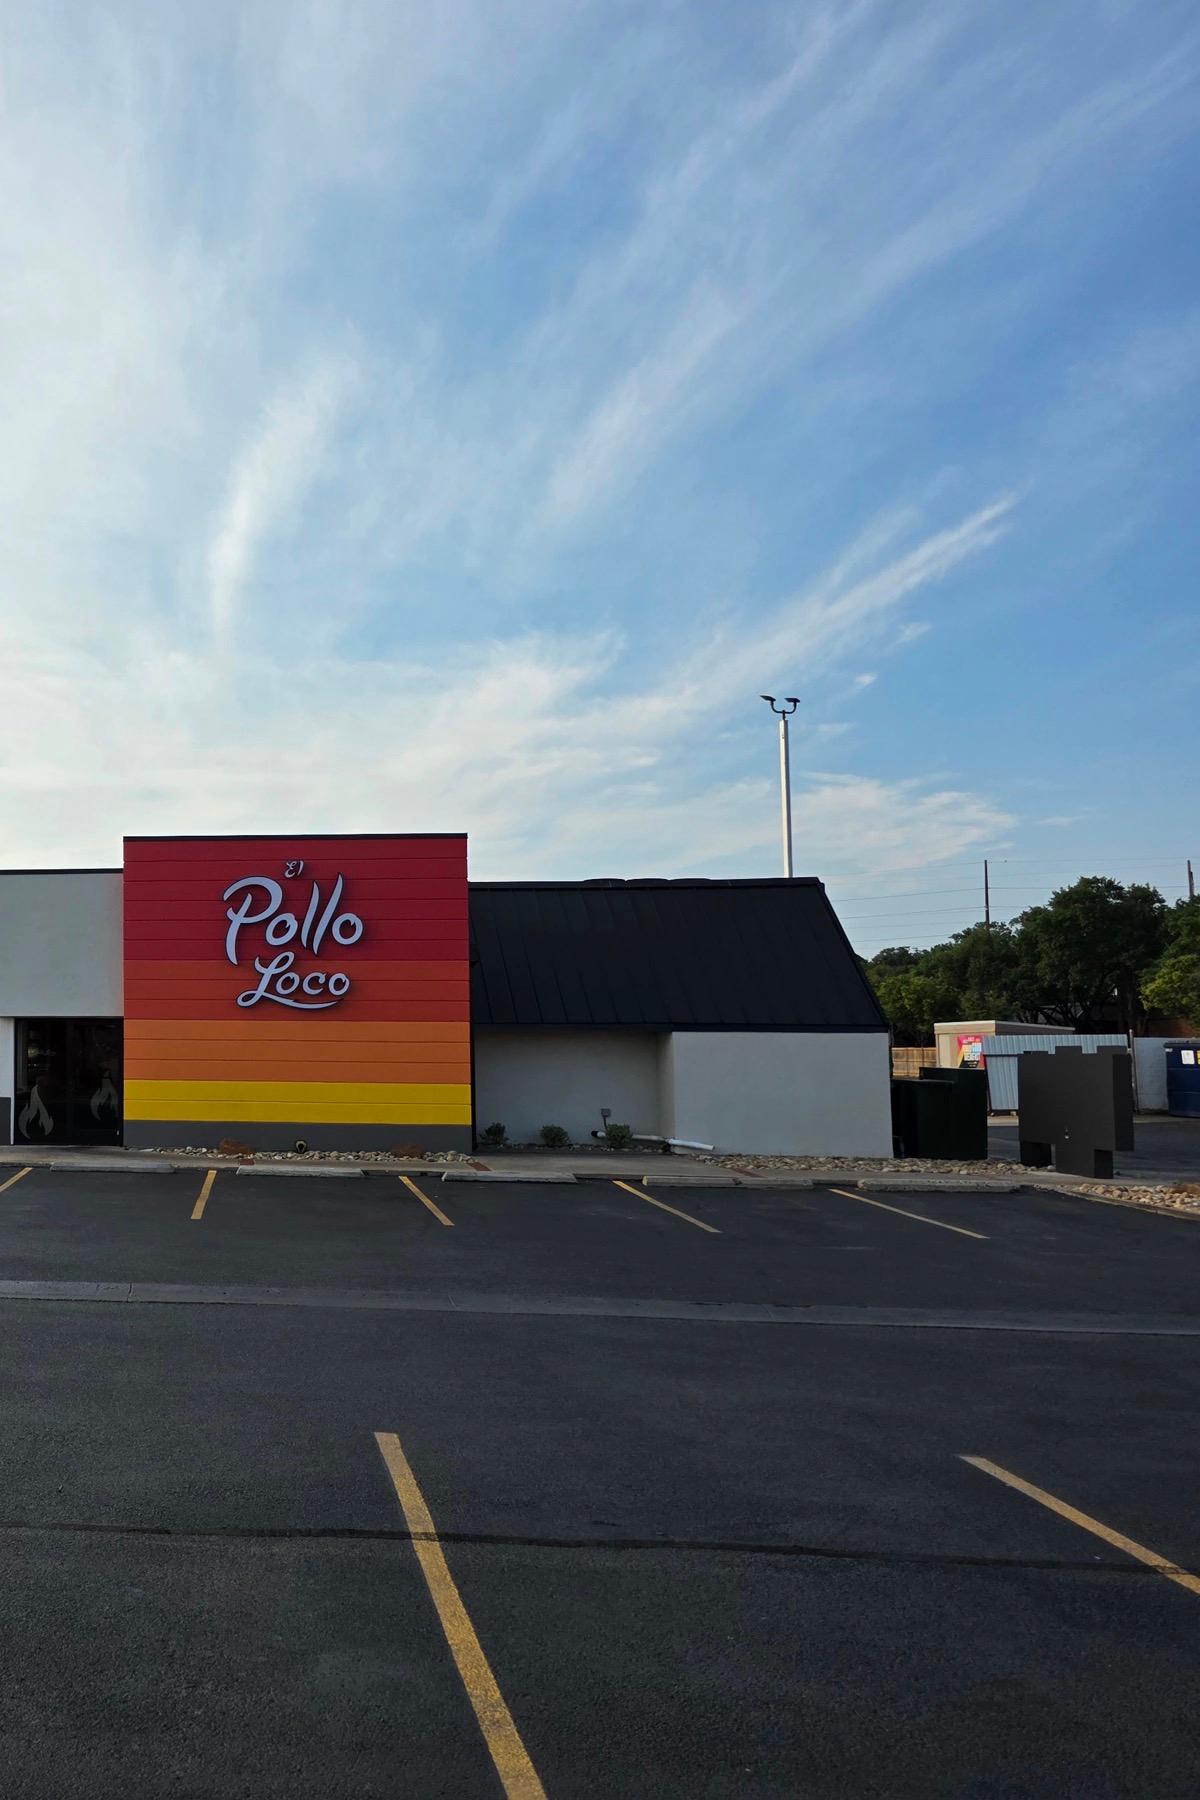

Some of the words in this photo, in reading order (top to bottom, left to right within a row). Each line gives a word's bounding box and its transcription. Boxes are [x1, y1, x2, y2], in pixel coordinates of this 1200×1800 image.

[284, 860, 304, 878] El
[223, 872, 364, 966] Pollo
[236, 951, 350, 1010] Loco
